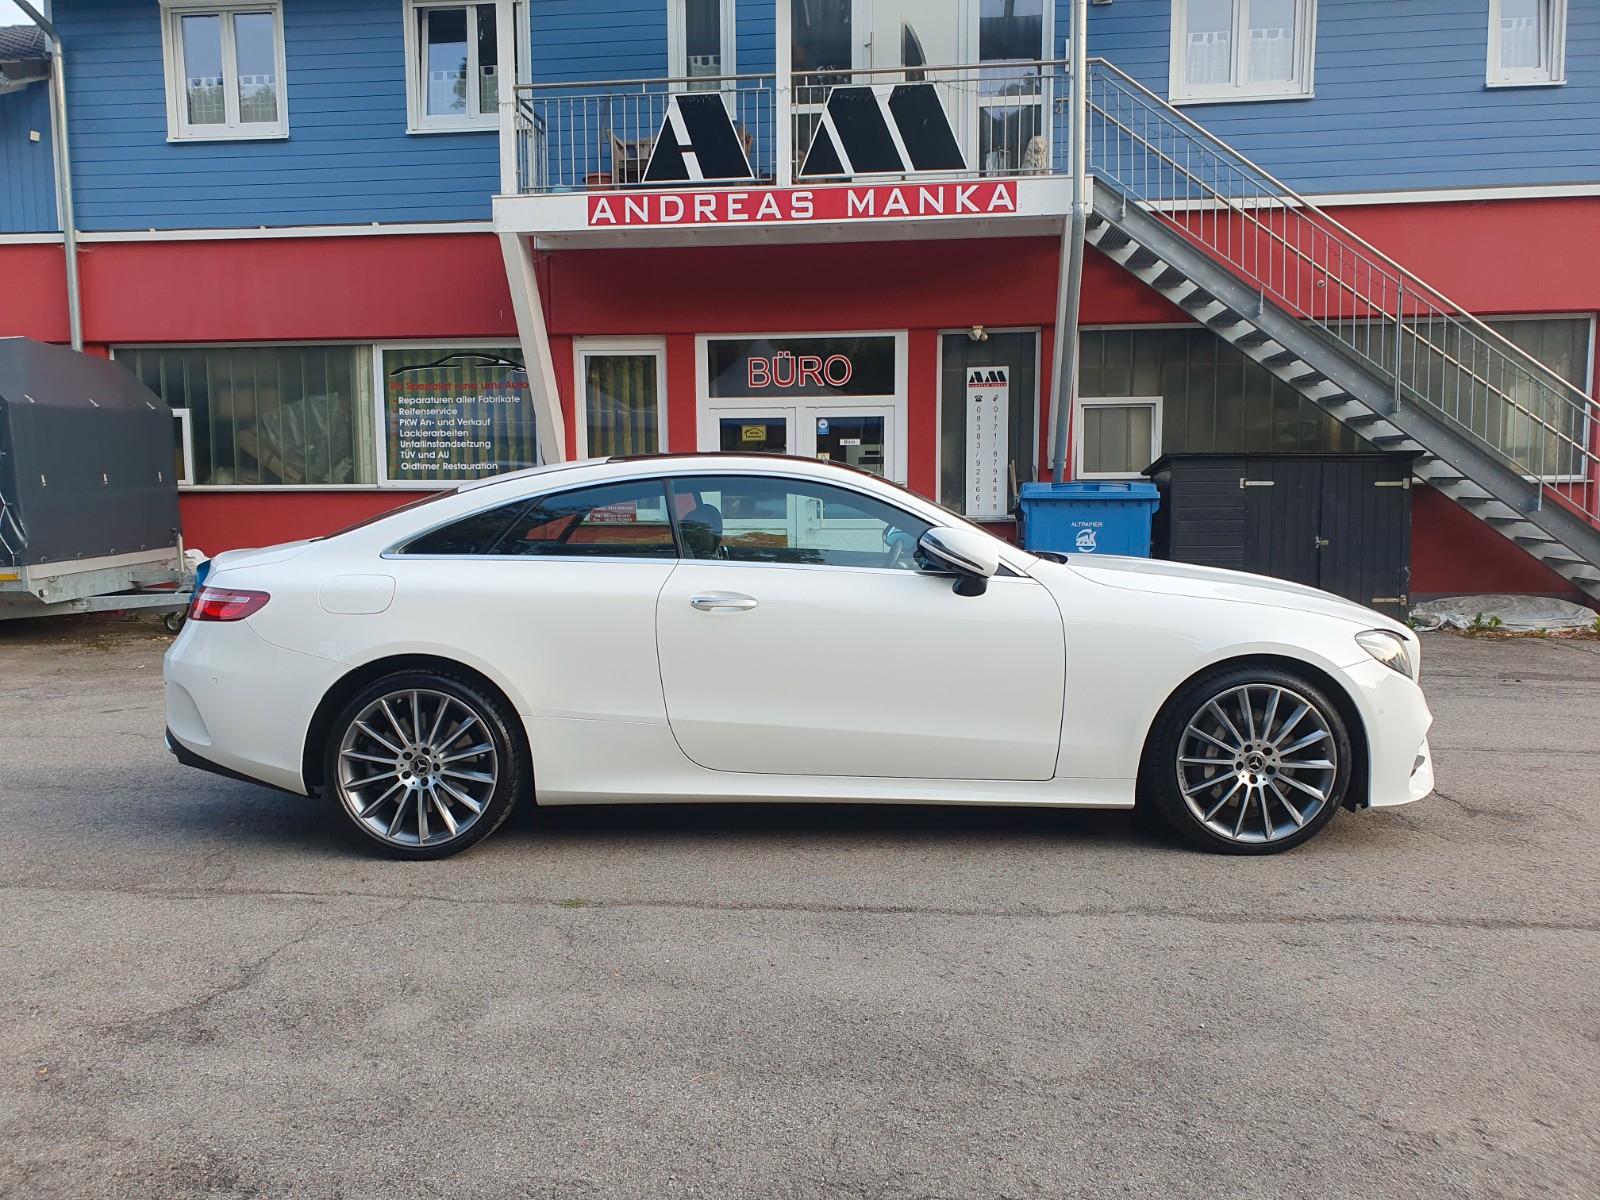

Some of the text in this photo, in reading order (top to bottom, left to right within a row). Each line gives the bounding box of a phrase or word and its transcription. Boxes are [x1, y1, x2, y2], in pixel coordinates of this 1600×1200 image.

[591, 184, 1015, 224] ANDREAS MANKA
[747, 351, 853, 387] BÜRO
[398, 395, 520, 405] Reparaturen aller Fabrikate
[399, 407, 458, 415] Reifenservice
[399, 418, 418, 426] PKW
[437, 417, 455, 425] und
[457, 417, 491, 426] Verkauf
[400, 429, 469, 437] Lackierarbeiten
[400, 440, 491, 449] Unfallinstandsetzung
[400, 450, 450, 459] TÜV und AU
[401, 461, 498, 470] Oldtimer Restauration
